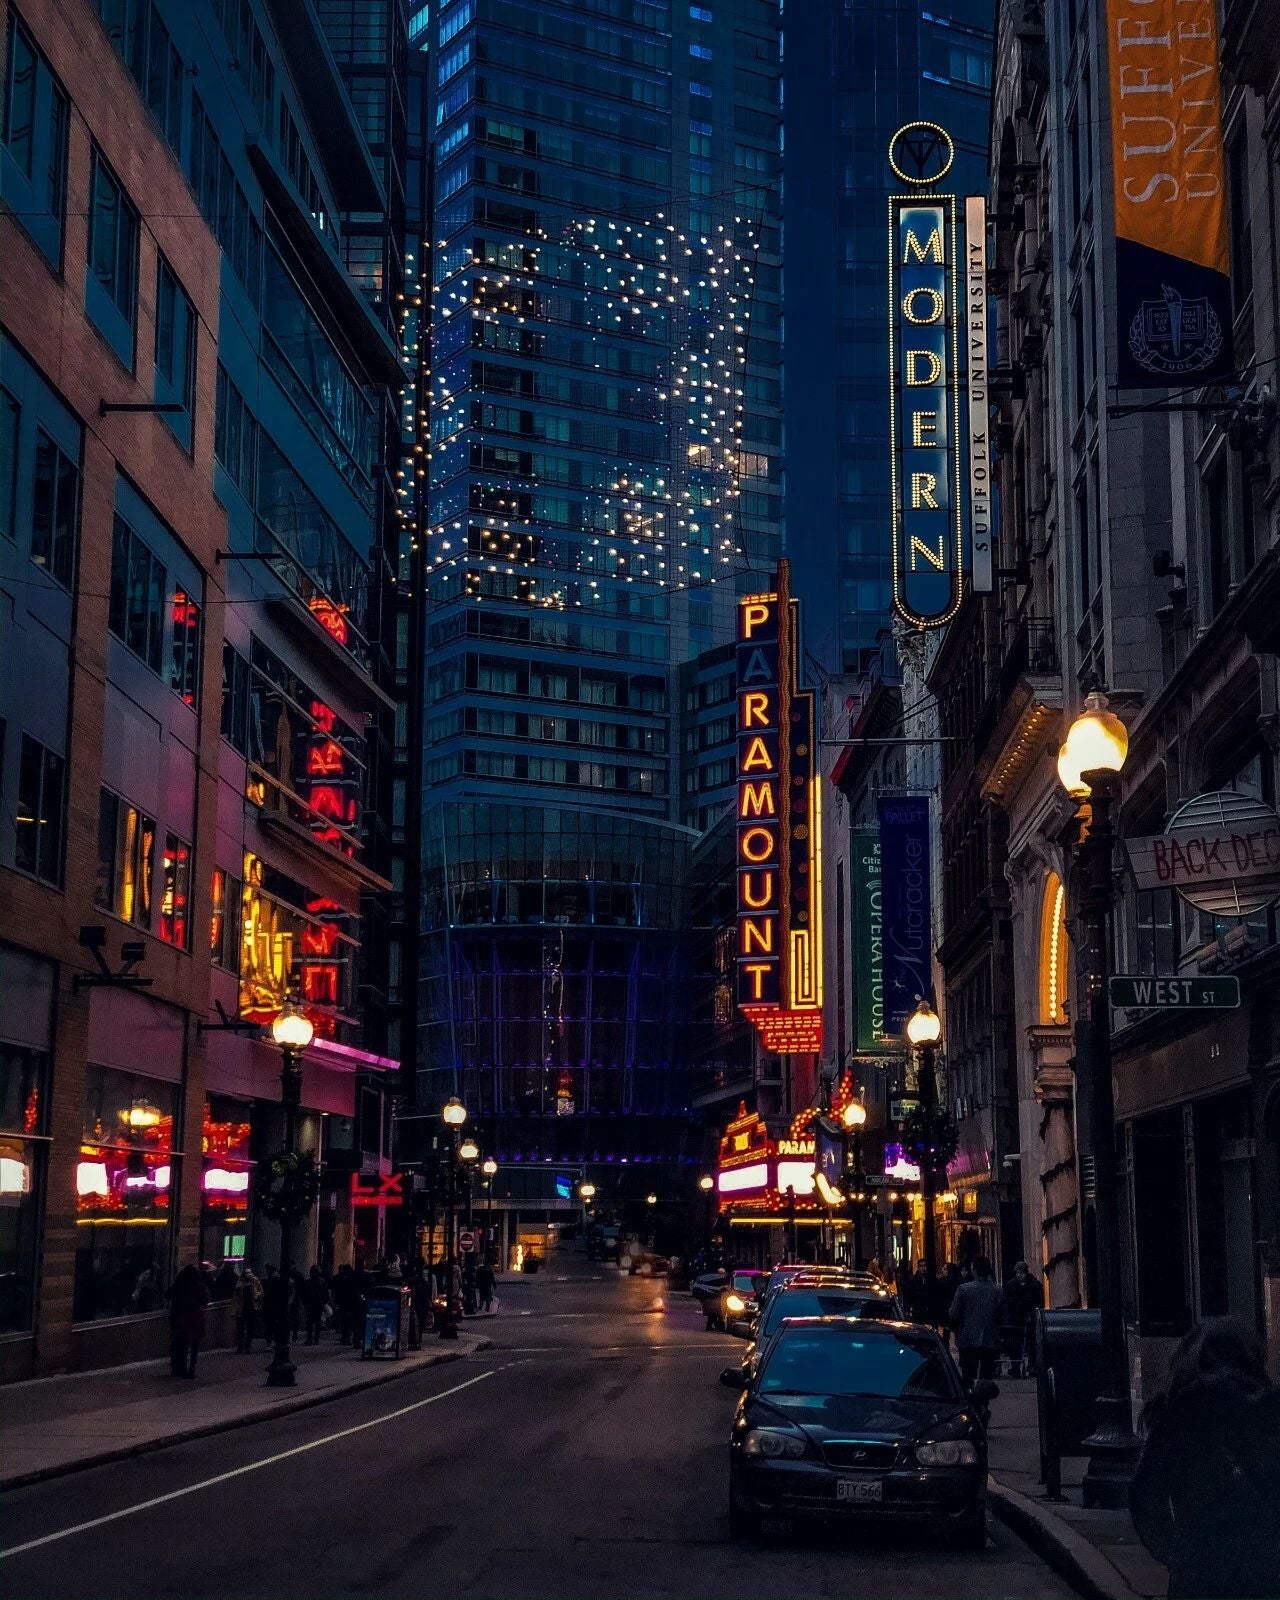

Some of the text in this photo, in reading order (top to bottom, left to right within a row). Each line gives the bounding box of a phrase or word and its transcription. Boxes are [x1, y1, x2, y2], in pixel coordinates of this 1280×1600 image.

[1116, 0, 1180, 204] SUFF
[1176, 0, 1222, 202] UNIVE
[903, 228, 945, 571] MODERN
[969, 242, 989, 552] SUFFOLK UNIVERSITY
[1161, 360, 1193, 371] 1906
[741, 603, 775, 1001] PARAMOUNT
[1153, 836, 1227, 881] BACK
[889, 833, 926, 995] Nutcracker
[1133, 980, 1216, 1005] WEST ST
